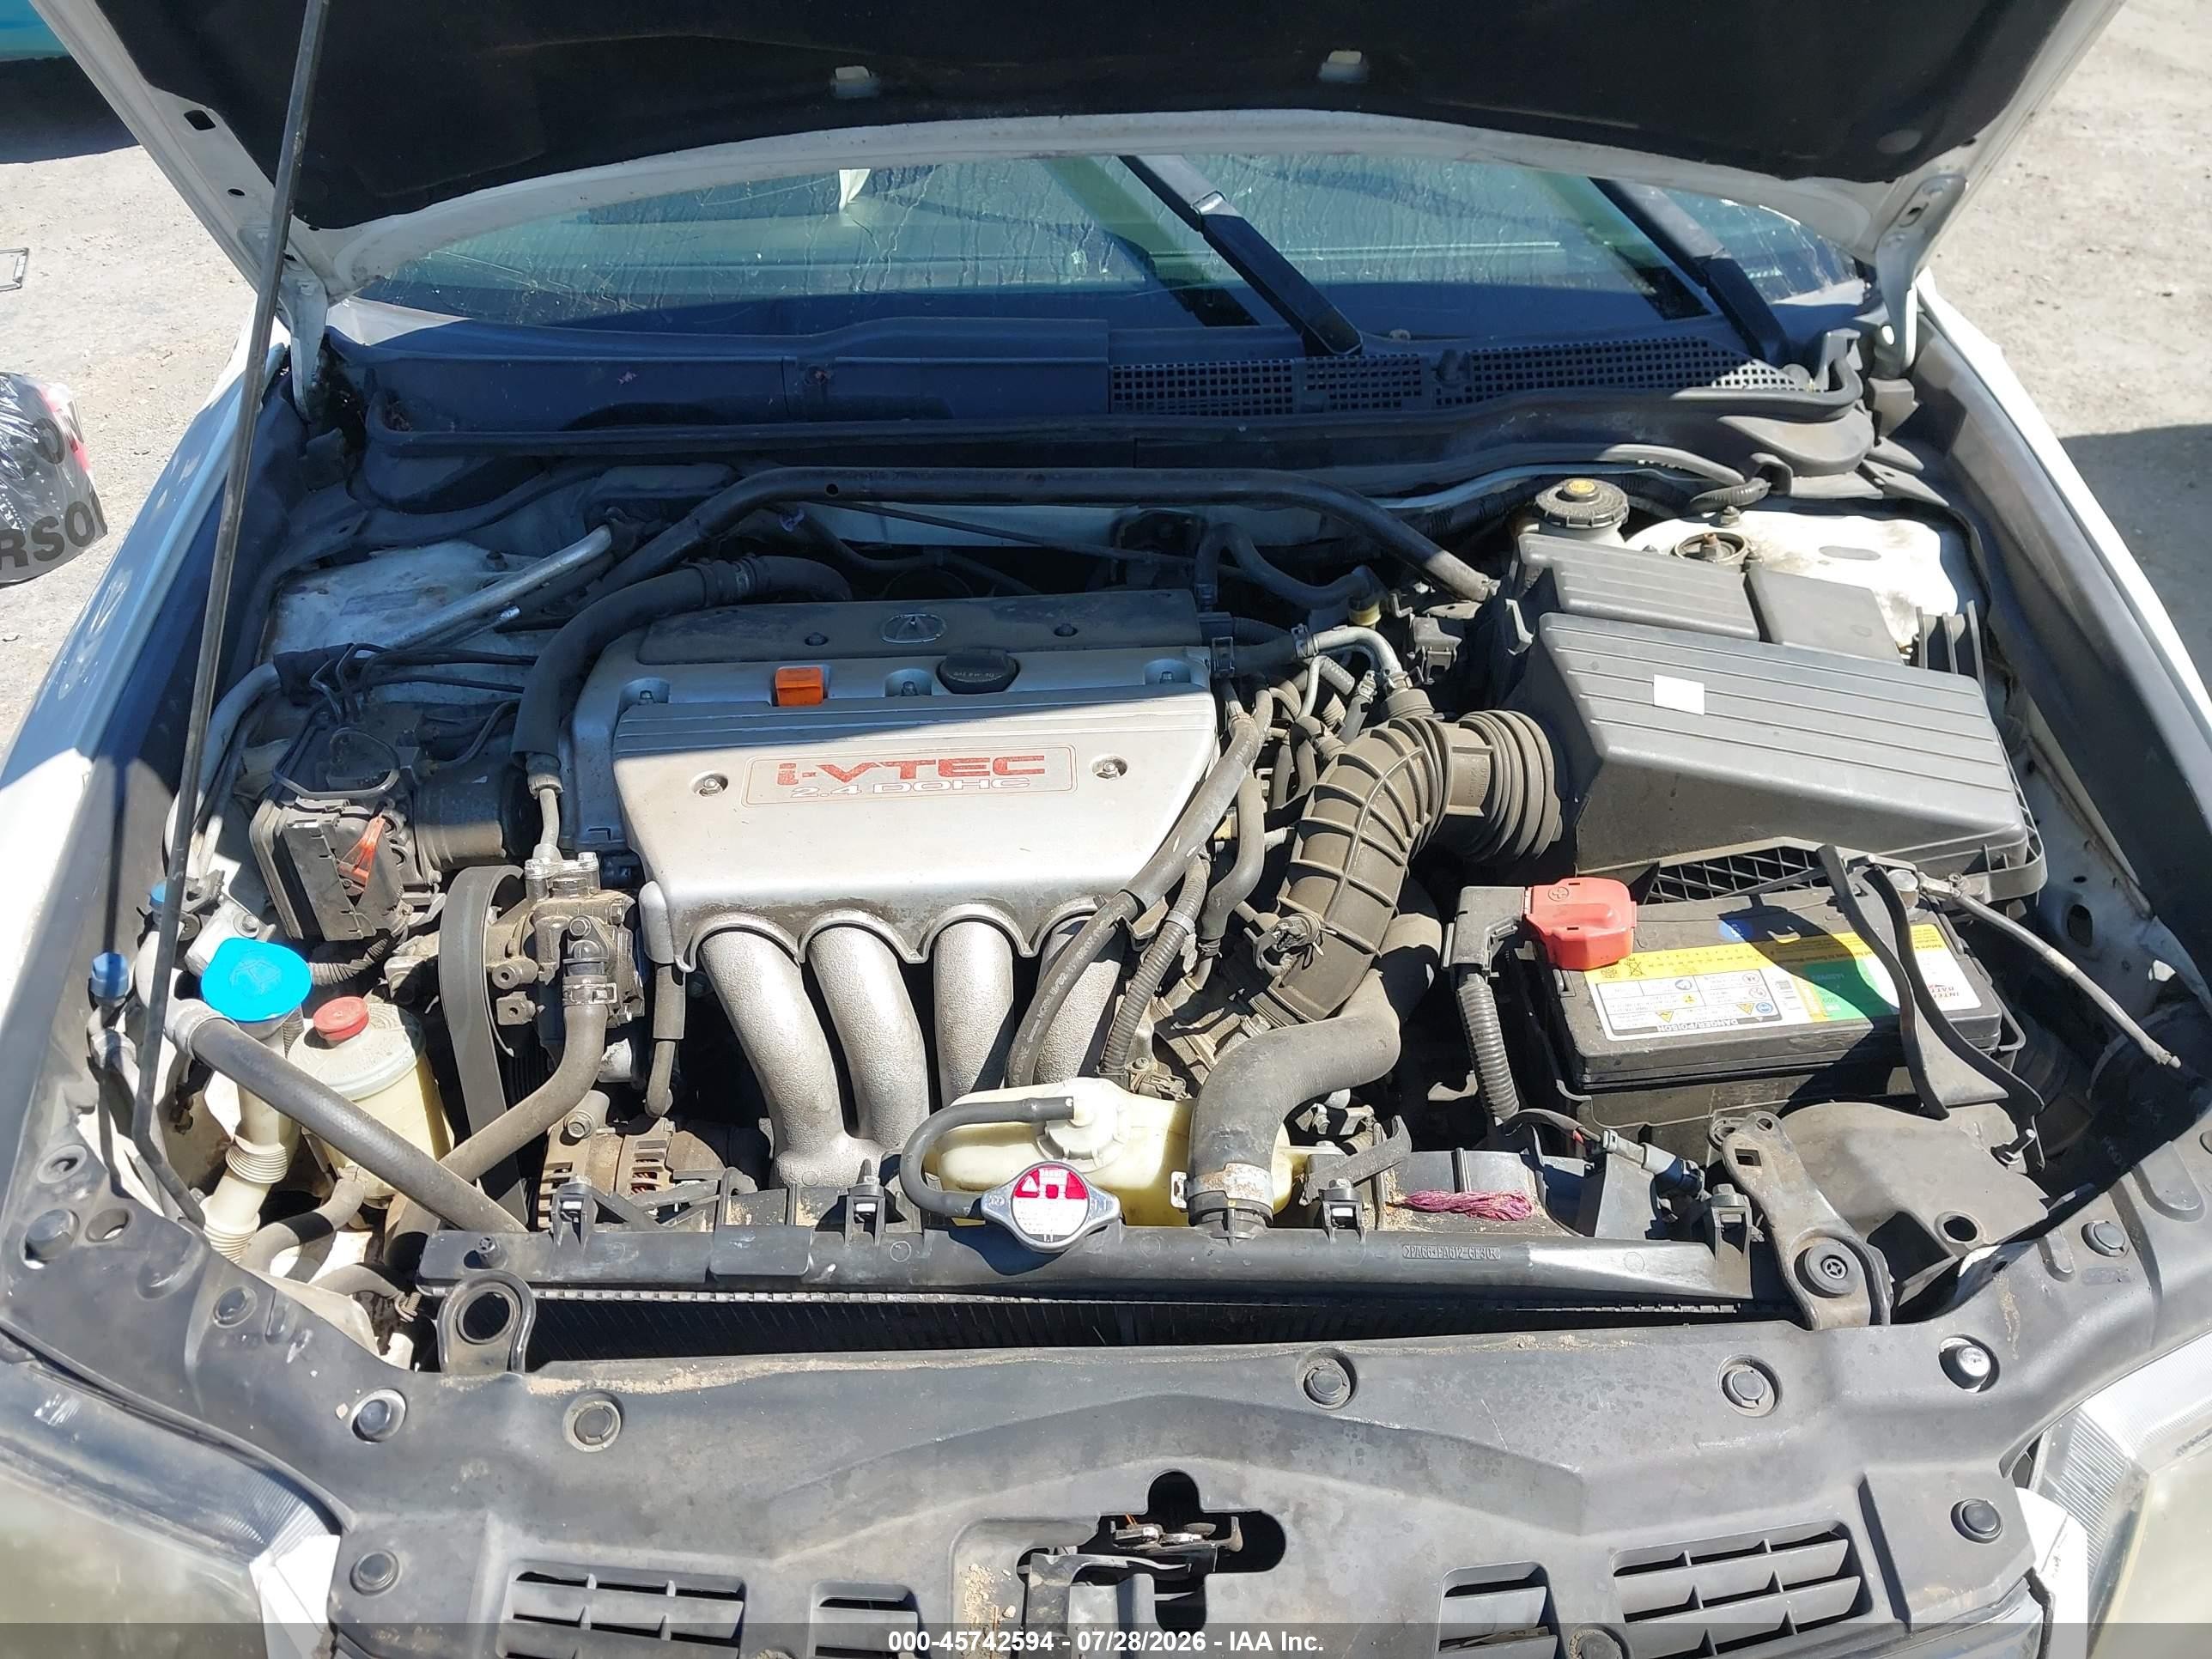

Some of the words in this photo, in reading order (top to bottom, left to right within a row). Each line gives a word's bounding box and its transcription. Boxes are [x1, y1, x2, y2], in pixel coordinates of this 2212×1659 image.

[776, 754, 1046, 786] i-VTEC
[790, 784, 862, 799] 2.4
[872, 776, 1031, 795] DOHC
[1657, 1018, 1739, 1033] DANGER/POISON
